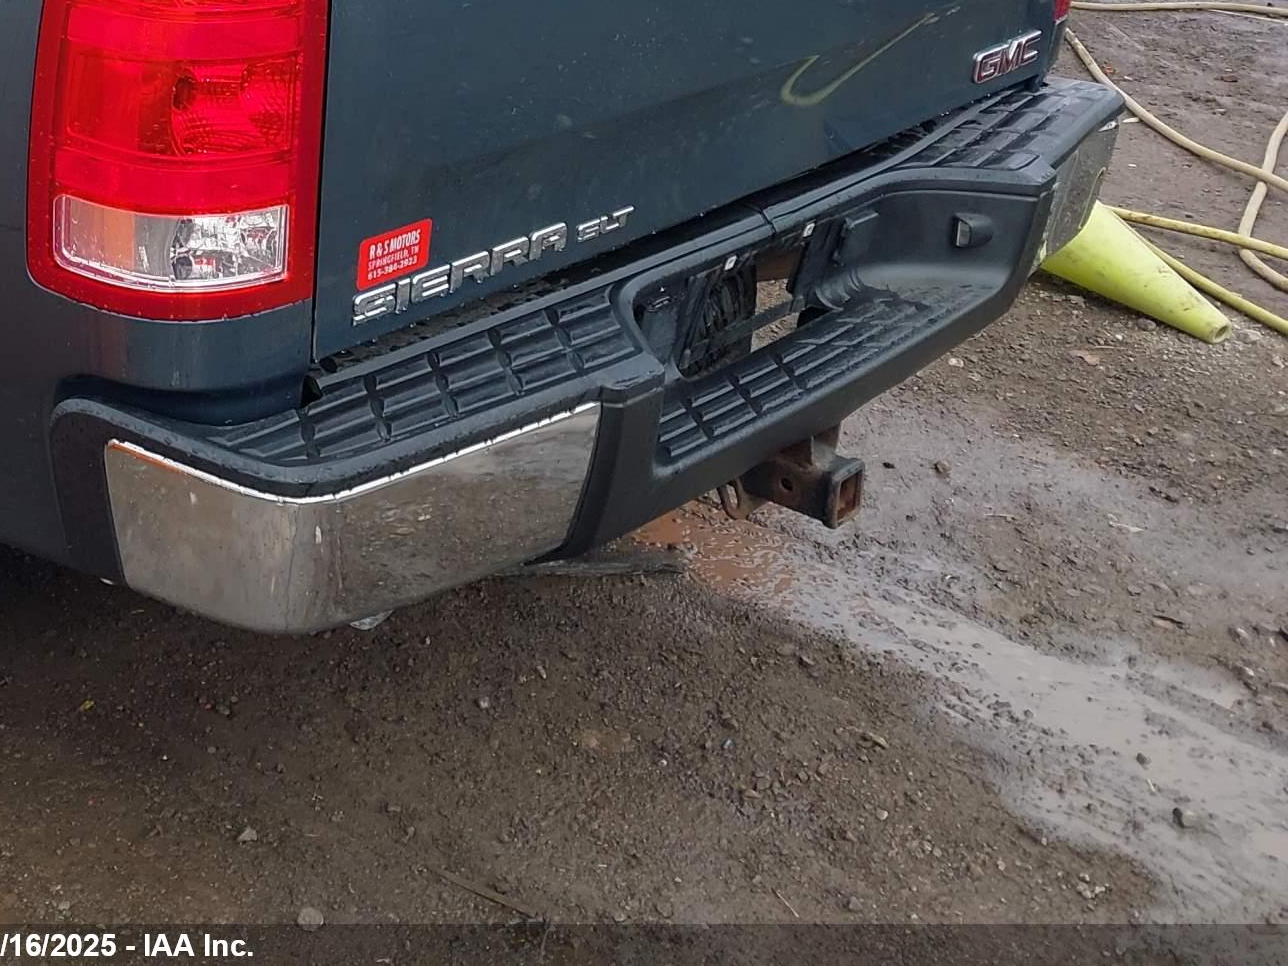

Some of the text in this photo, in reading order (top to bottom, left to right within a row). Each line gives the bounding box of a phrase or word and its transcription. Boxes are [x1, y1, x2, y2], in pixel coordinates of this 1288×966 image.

[972, 30, 1042, 84] GMC
[352, 205, 635, 326] SIERRA SLT
[390, 228, 421, 253] MOTORS
